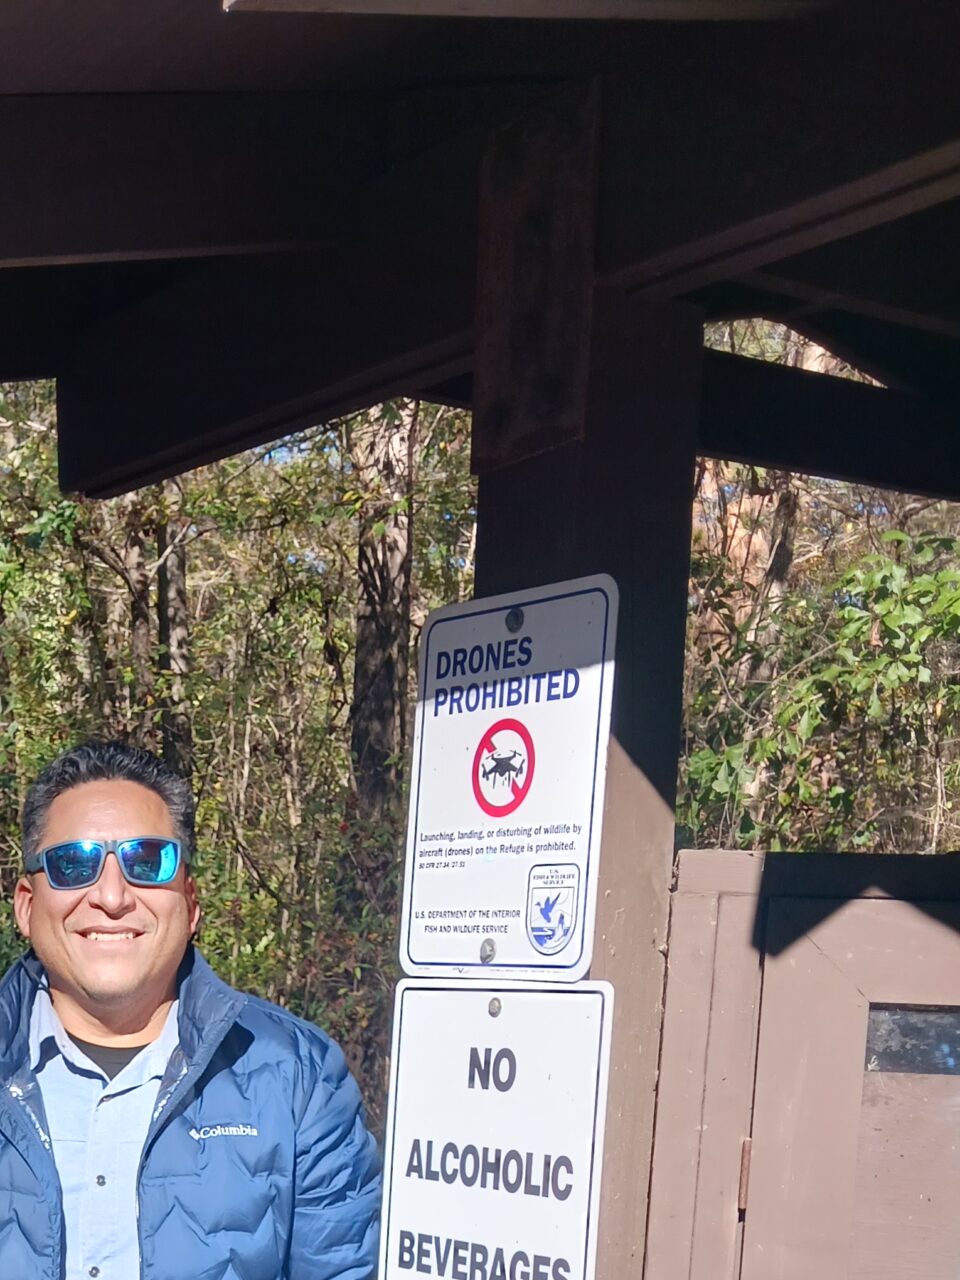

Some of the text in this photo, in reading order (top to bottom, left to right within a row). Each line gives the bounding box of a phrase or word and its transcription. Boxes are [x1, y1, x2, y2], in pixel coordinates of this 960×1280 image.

[436, 636, 533, 680] DRONES
[433, 668, 580, 717] PROHIBITED
[420, 824, 582, 842] Launching, landing, or disturbing of wildlife by
[419, 848, 443, 857] aircraft
[445, 846, 473, 858] (drones)
[486, 846, 497, 854] the
[500, 844, 525, 855] Refuge
[527, 843, 533, 852] is
[536, 841, 576, 854] prohibited.
[415, 909, 520, 919] U.S. DEPARTMENT OF THE INTERIOR
[425, 925, 508, 933] FISH AND WILDLIFE SERVICE
[467, 1046, 517, 1092] NO
[200, 1124, 258, 1139] Columbia
[405, 1138, 574, 1201] ALCOHOLIC
